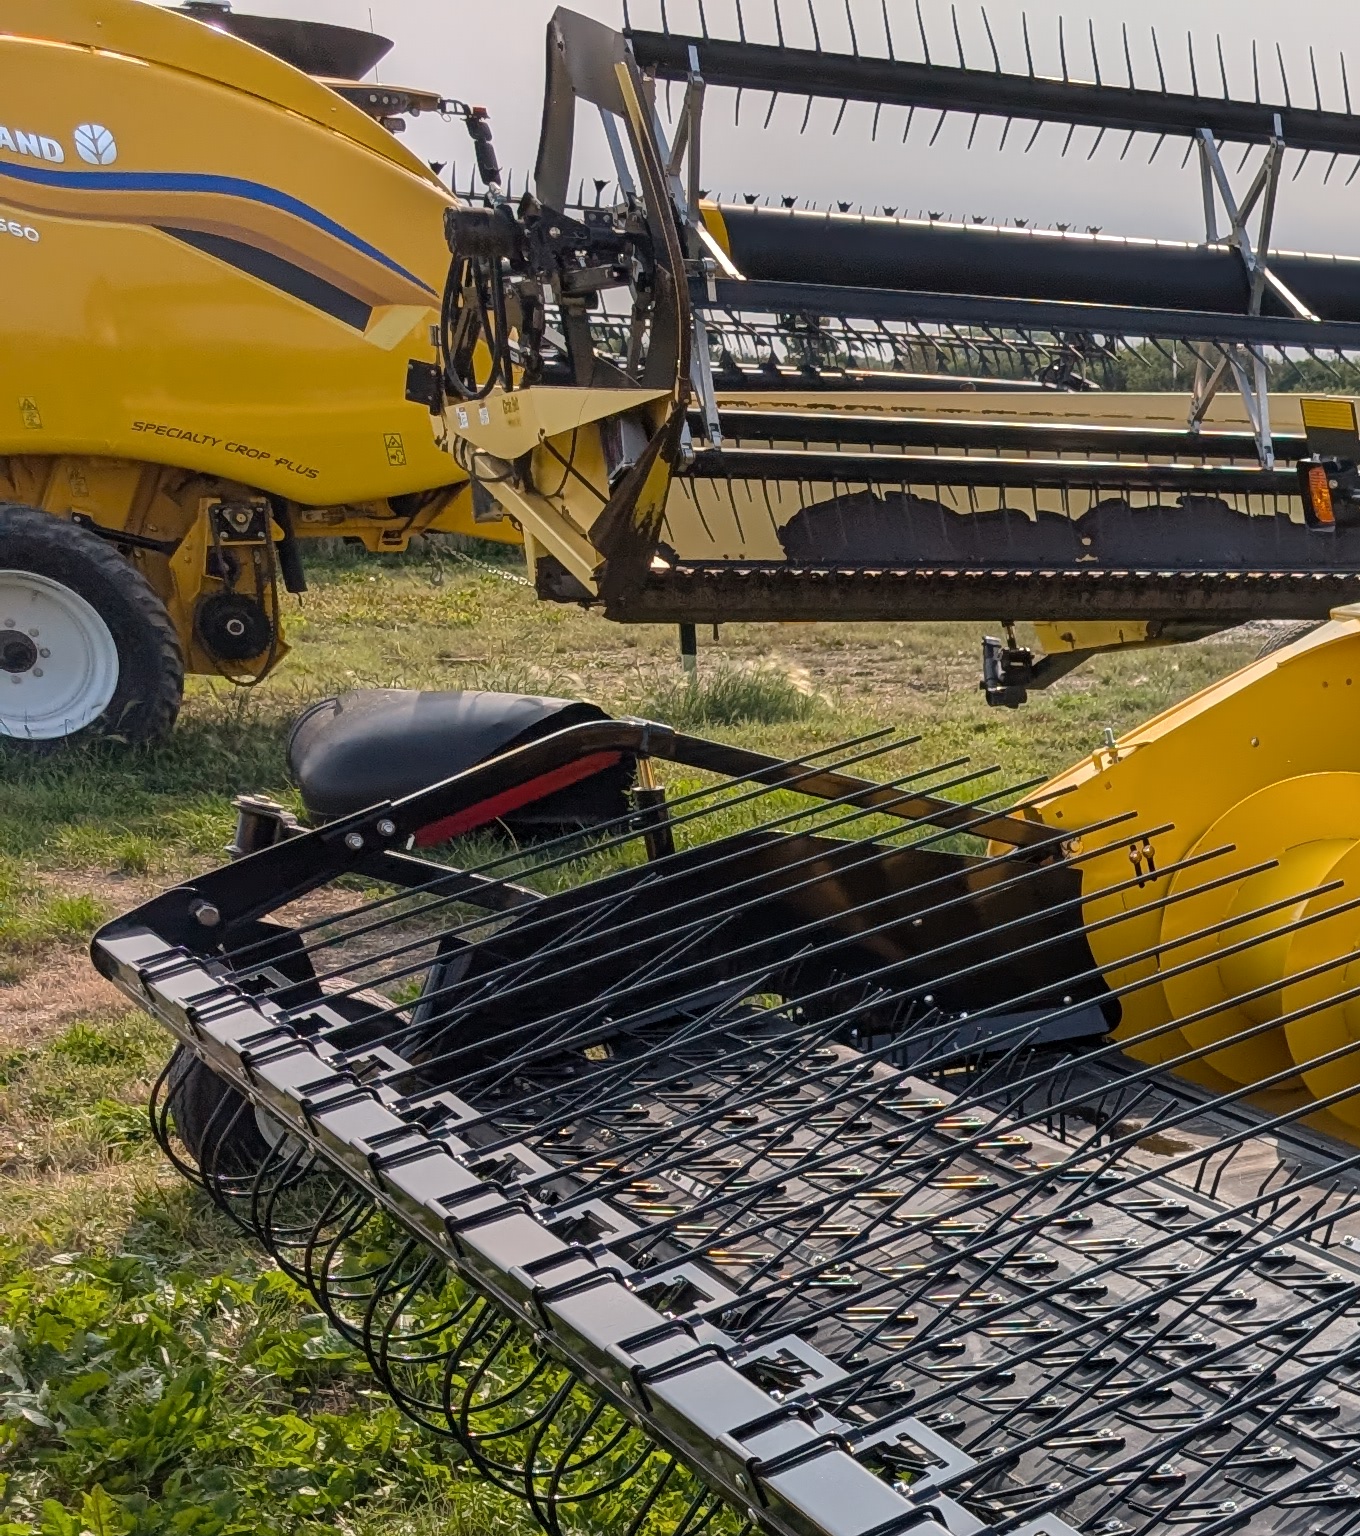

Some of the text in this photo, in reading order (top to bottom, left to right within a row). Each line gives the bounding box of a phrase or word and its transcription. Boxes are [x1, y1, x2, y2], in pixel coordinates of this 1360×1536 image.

[131, 421, 320, 479] SPECIALTY CROP PLUS
